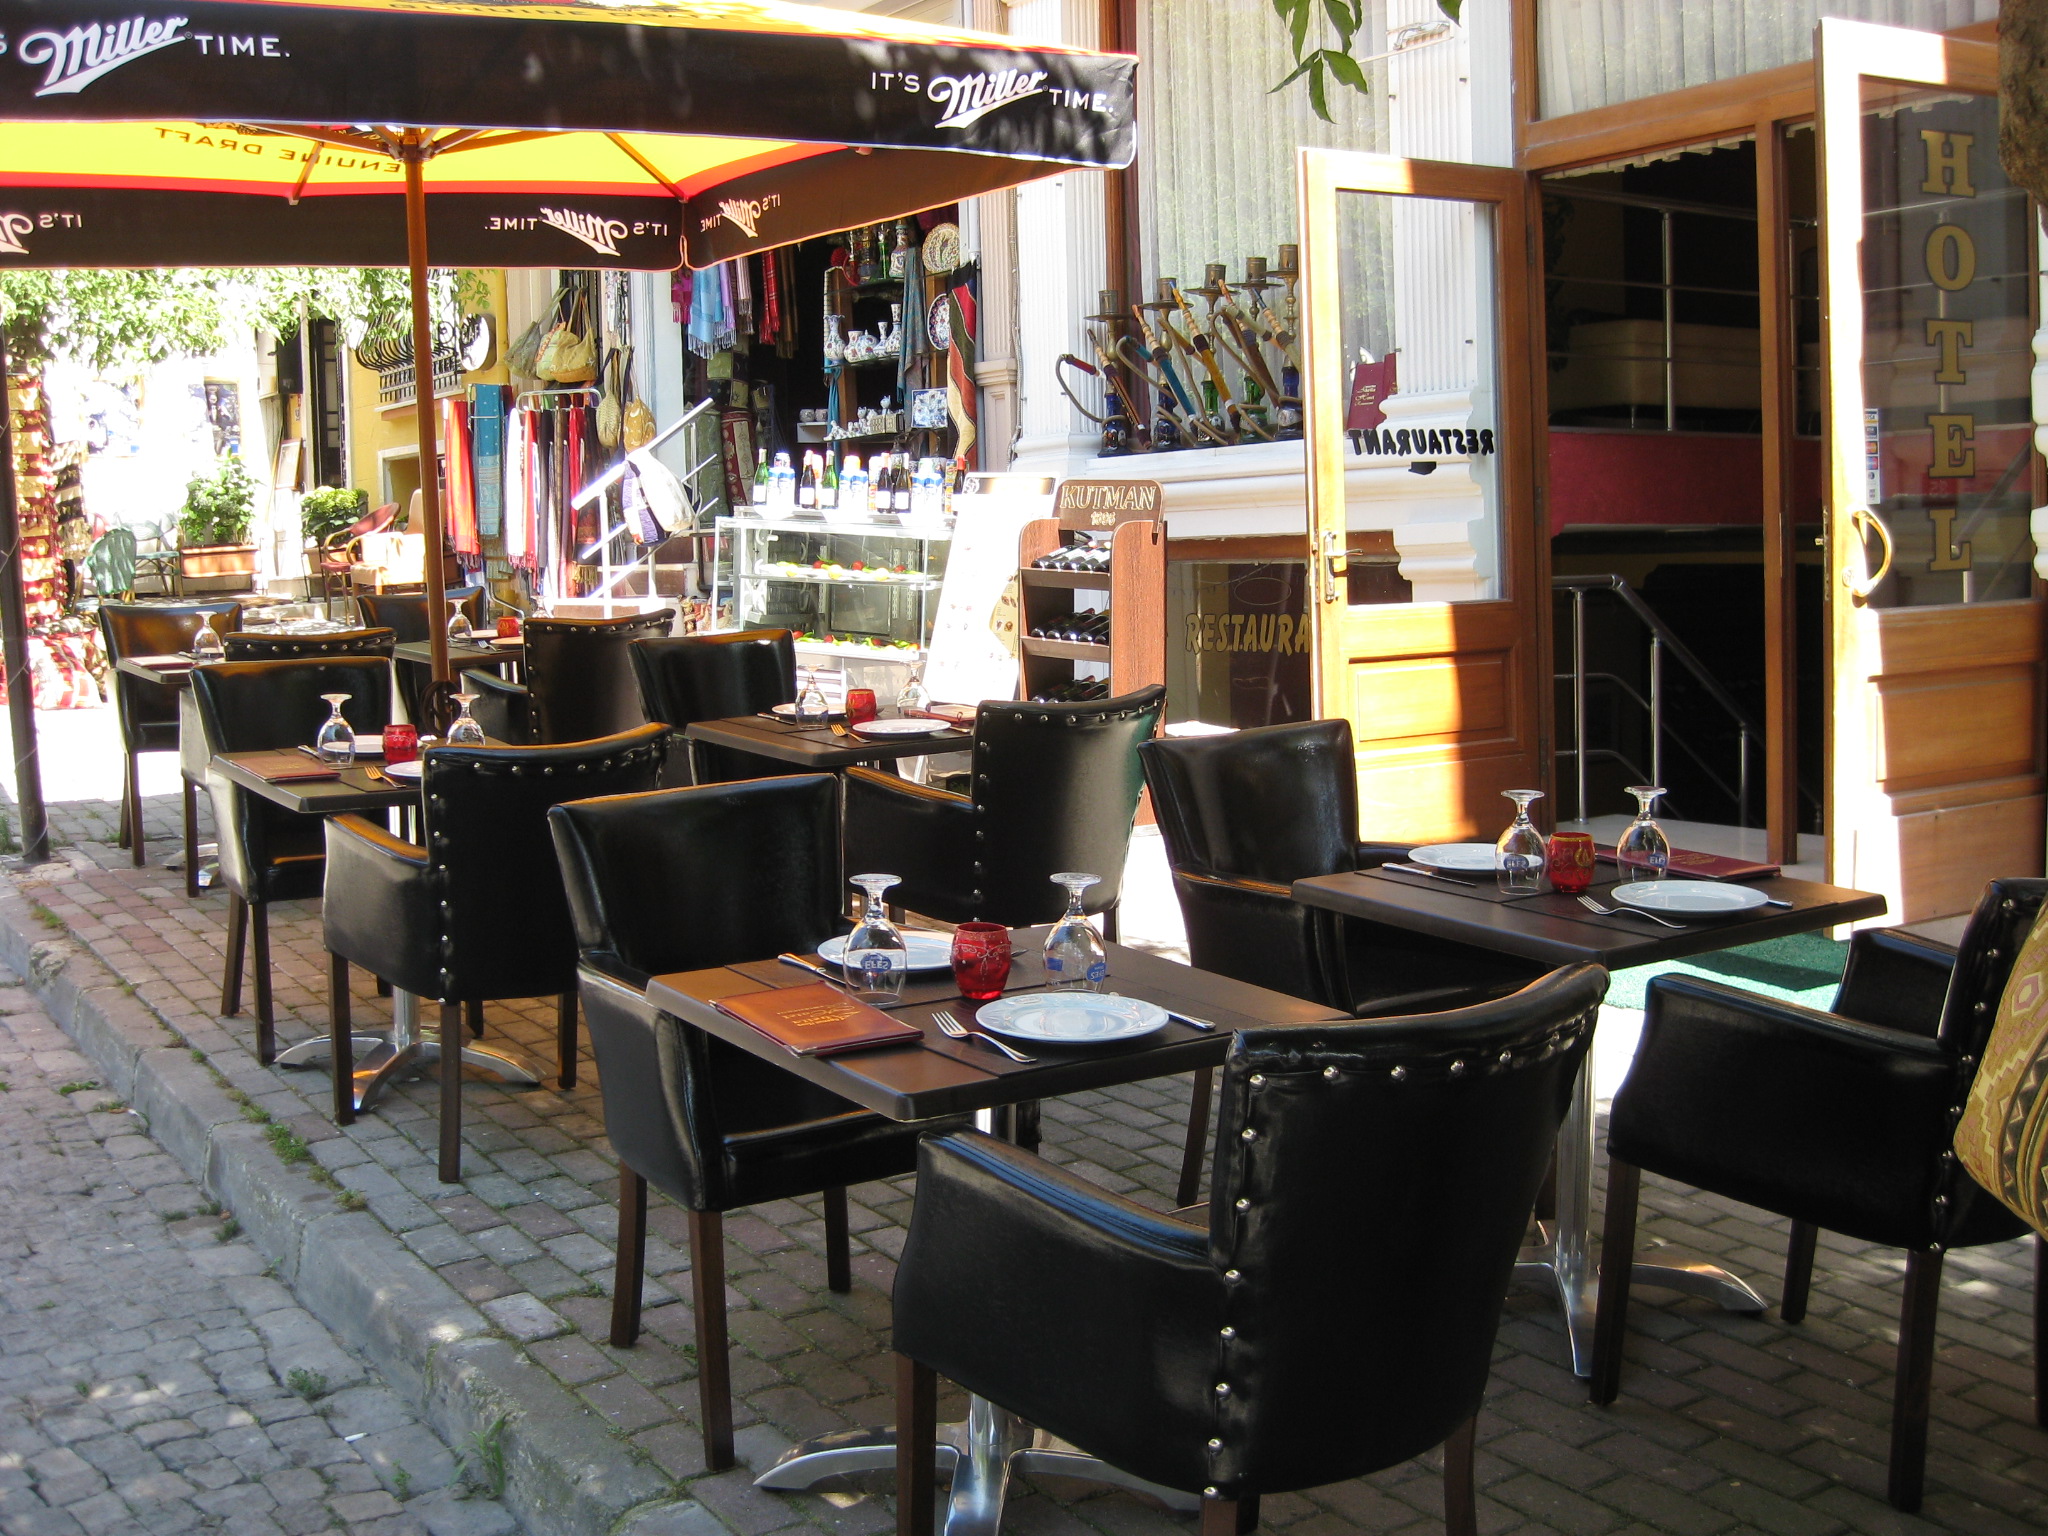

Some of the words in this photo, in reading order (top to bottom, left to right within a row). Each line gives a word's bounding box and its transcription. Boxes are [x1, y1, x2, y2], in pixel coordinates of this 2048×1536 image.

[19, 16, 188, 97] Miller
[871, 72, 921, 93] IT'S
[927, 68, 1048, 129] Miller
[1920, 129, 1976, 573] HOTEL
[1060, 485, 1157, 511] KUTMAN
[1185, 612, 1310, 656] RESTAURA
